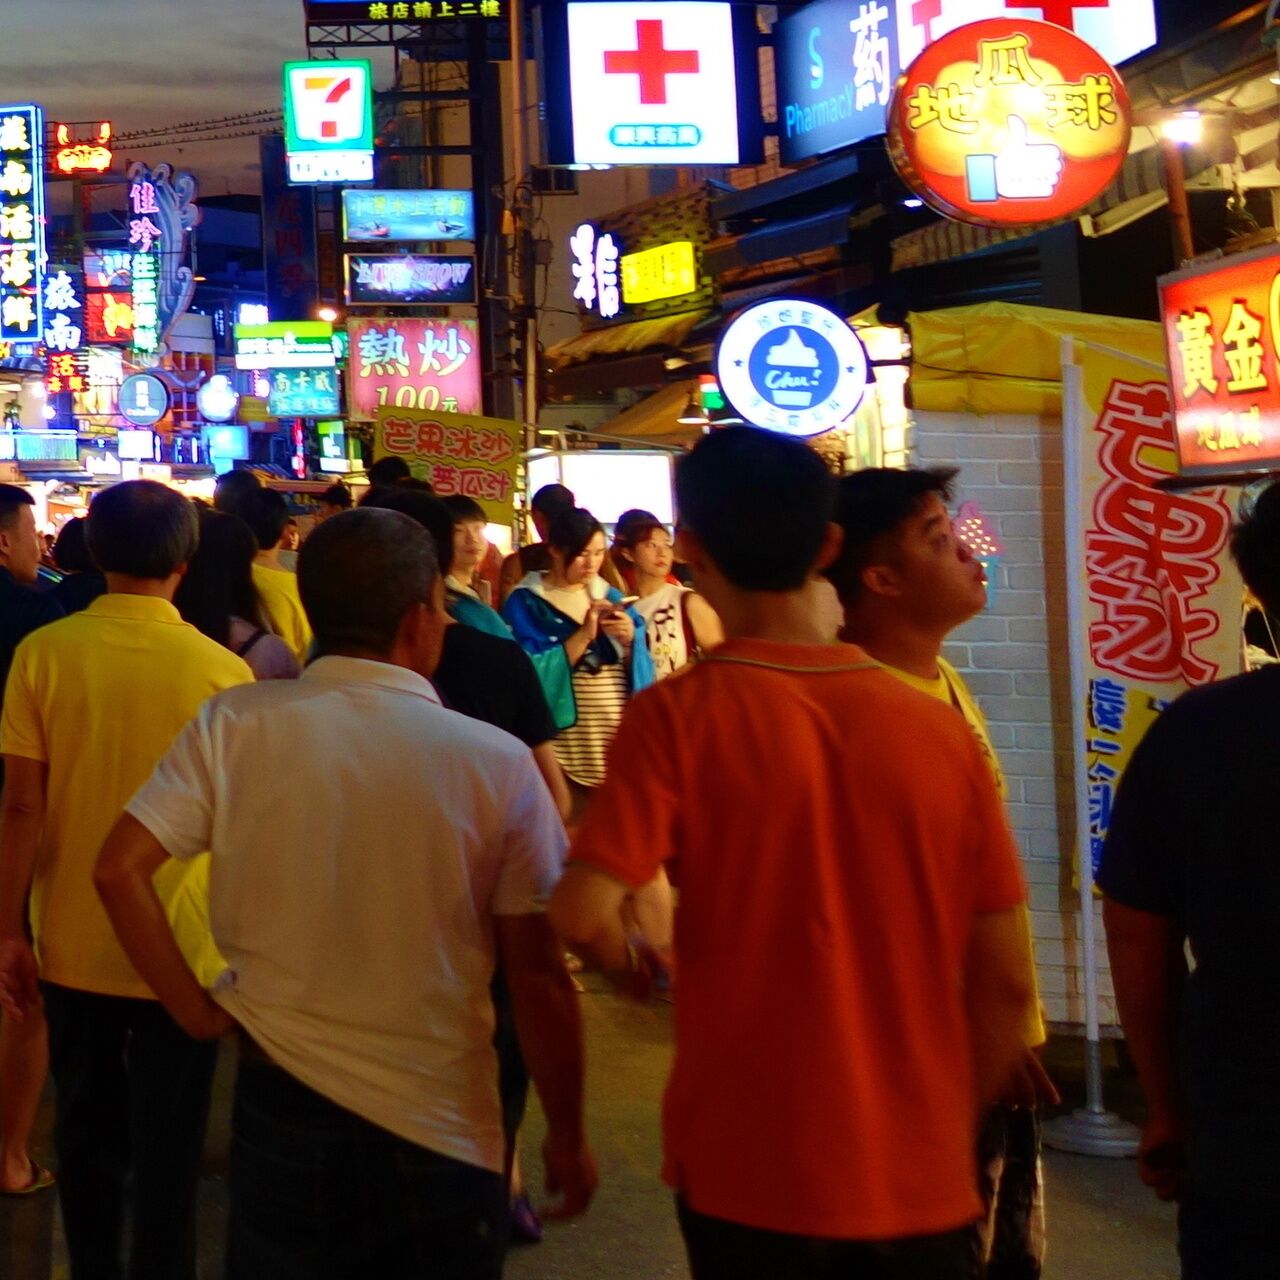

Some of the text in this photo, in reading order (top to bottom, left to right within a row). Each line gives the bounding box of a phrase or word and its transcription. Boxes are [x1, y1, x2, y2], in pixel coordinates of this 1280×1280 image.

[785, 82, 854, 139] Pharmacy
[909, 34, 1118, 135] 地瓜球
[359, 327, 472, 378] 熱炒
[1176, 298, 1269, 400] 黃金
[383, 416, 513, 464] 芒果冰沙
